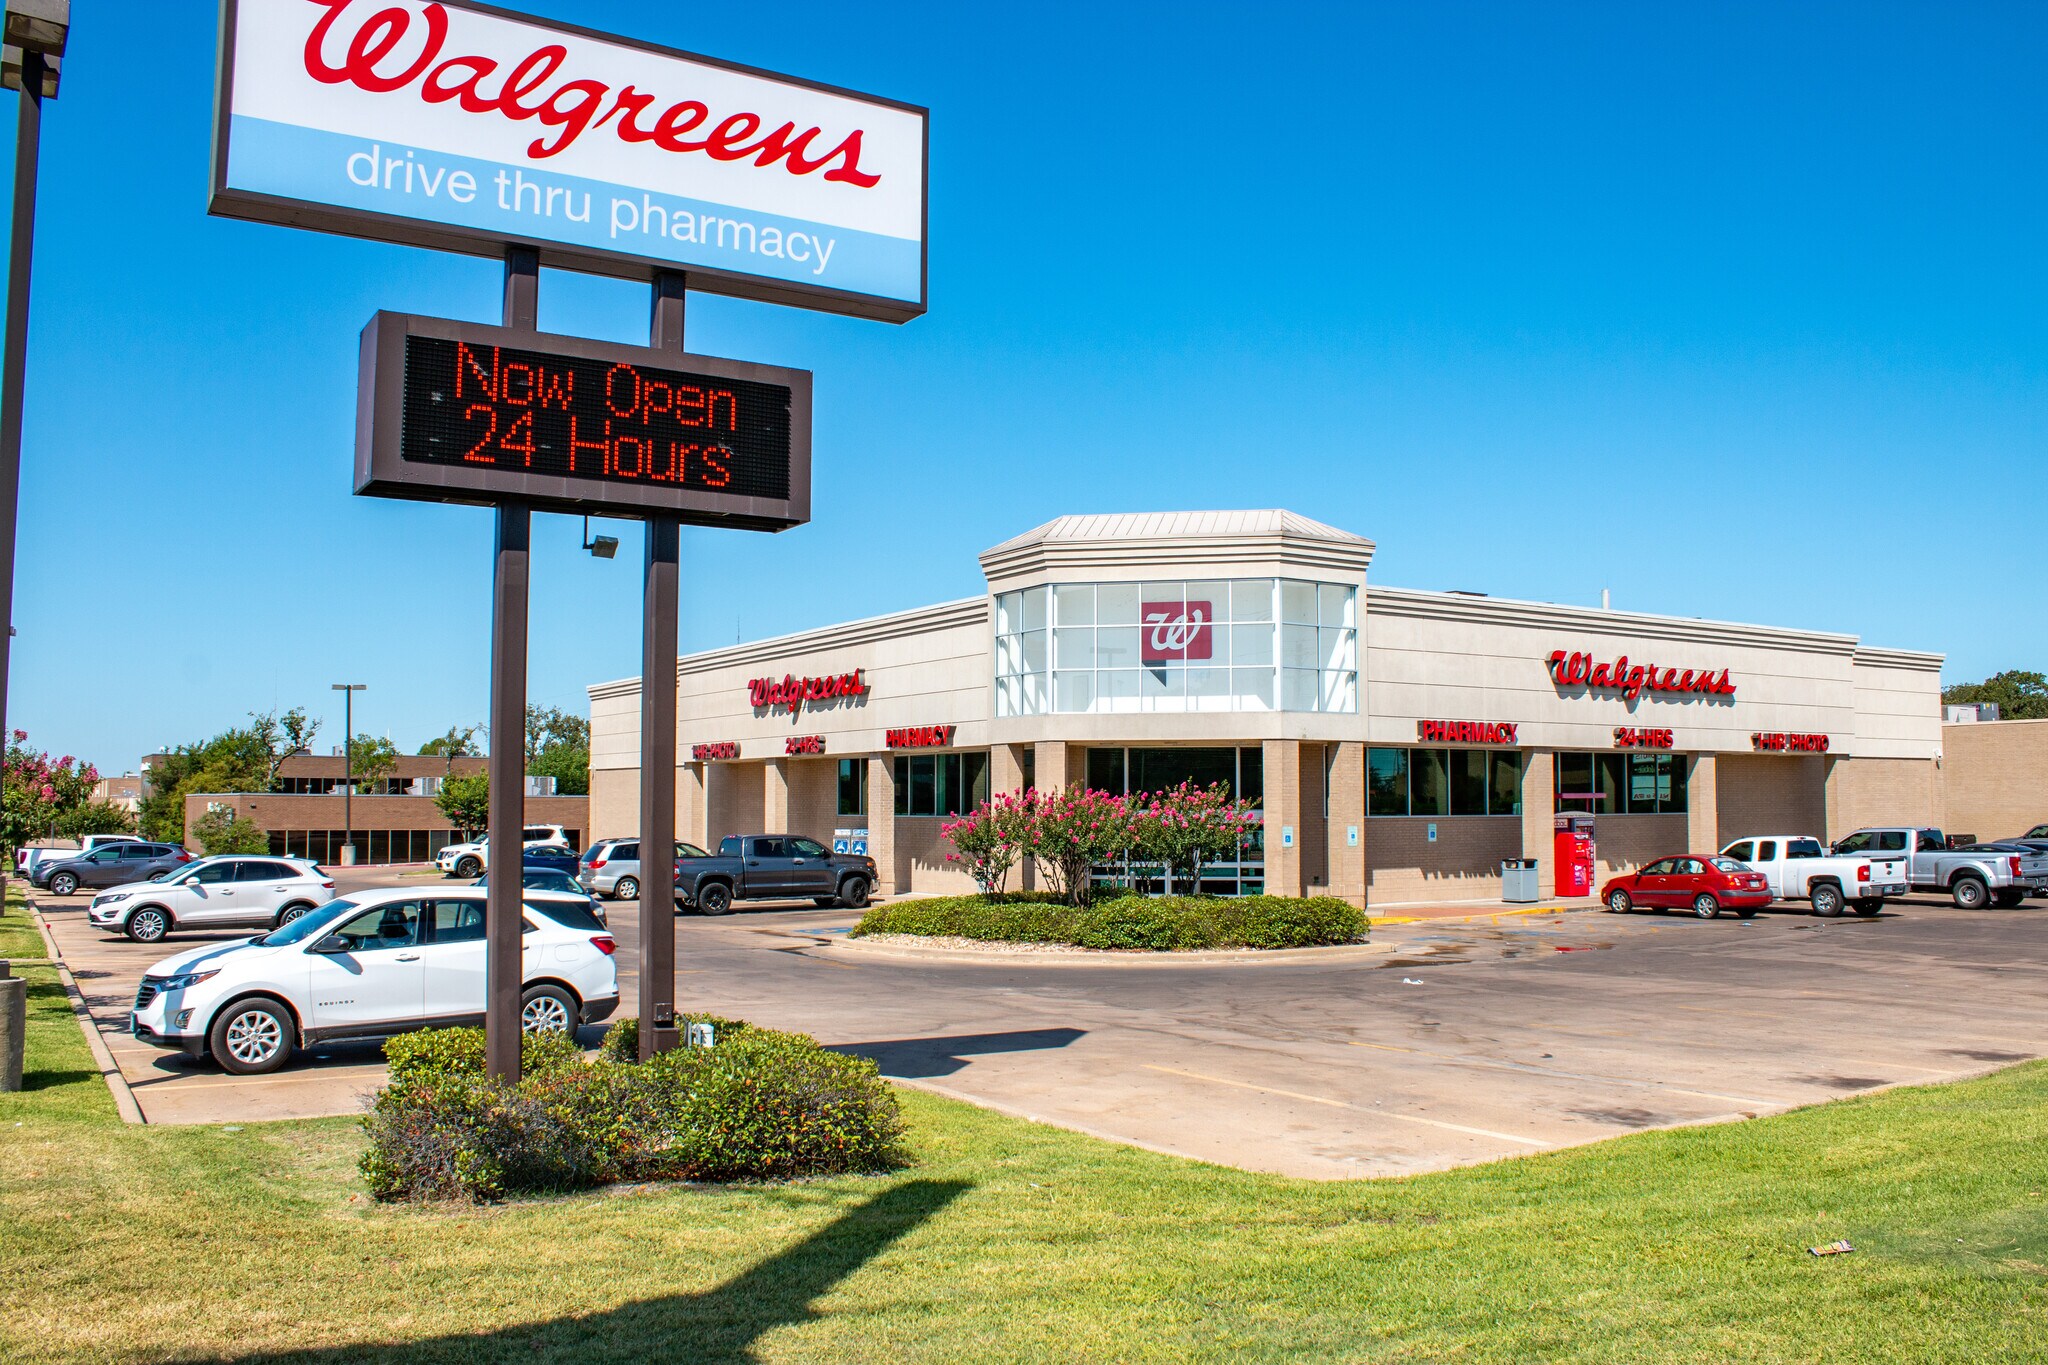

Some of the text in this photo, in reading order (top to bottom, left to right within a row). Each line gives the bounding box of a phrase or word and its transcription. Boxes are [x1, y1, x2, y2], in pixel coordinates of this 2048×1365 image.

[304, 0, 881, 189] Walgreens
[347, 144, 836, 275] drive thru pharmacy
[457, 342, 736, 431] Now Open
[465, 405, 731, 487] 24 Hours
[748, 668, 865, 713] Walgreens
[1551, 650, 1737, 700] Walgreens
[785, 735, 820, 755] 24-HRS
[886, 726, 951, 748] PHARMACY
[1423, 720, 1518, 745] PHARMACY
[1618, 727, 1673, 748] 24-HRS
[1791, 734, 1829, 752] PHOTO
